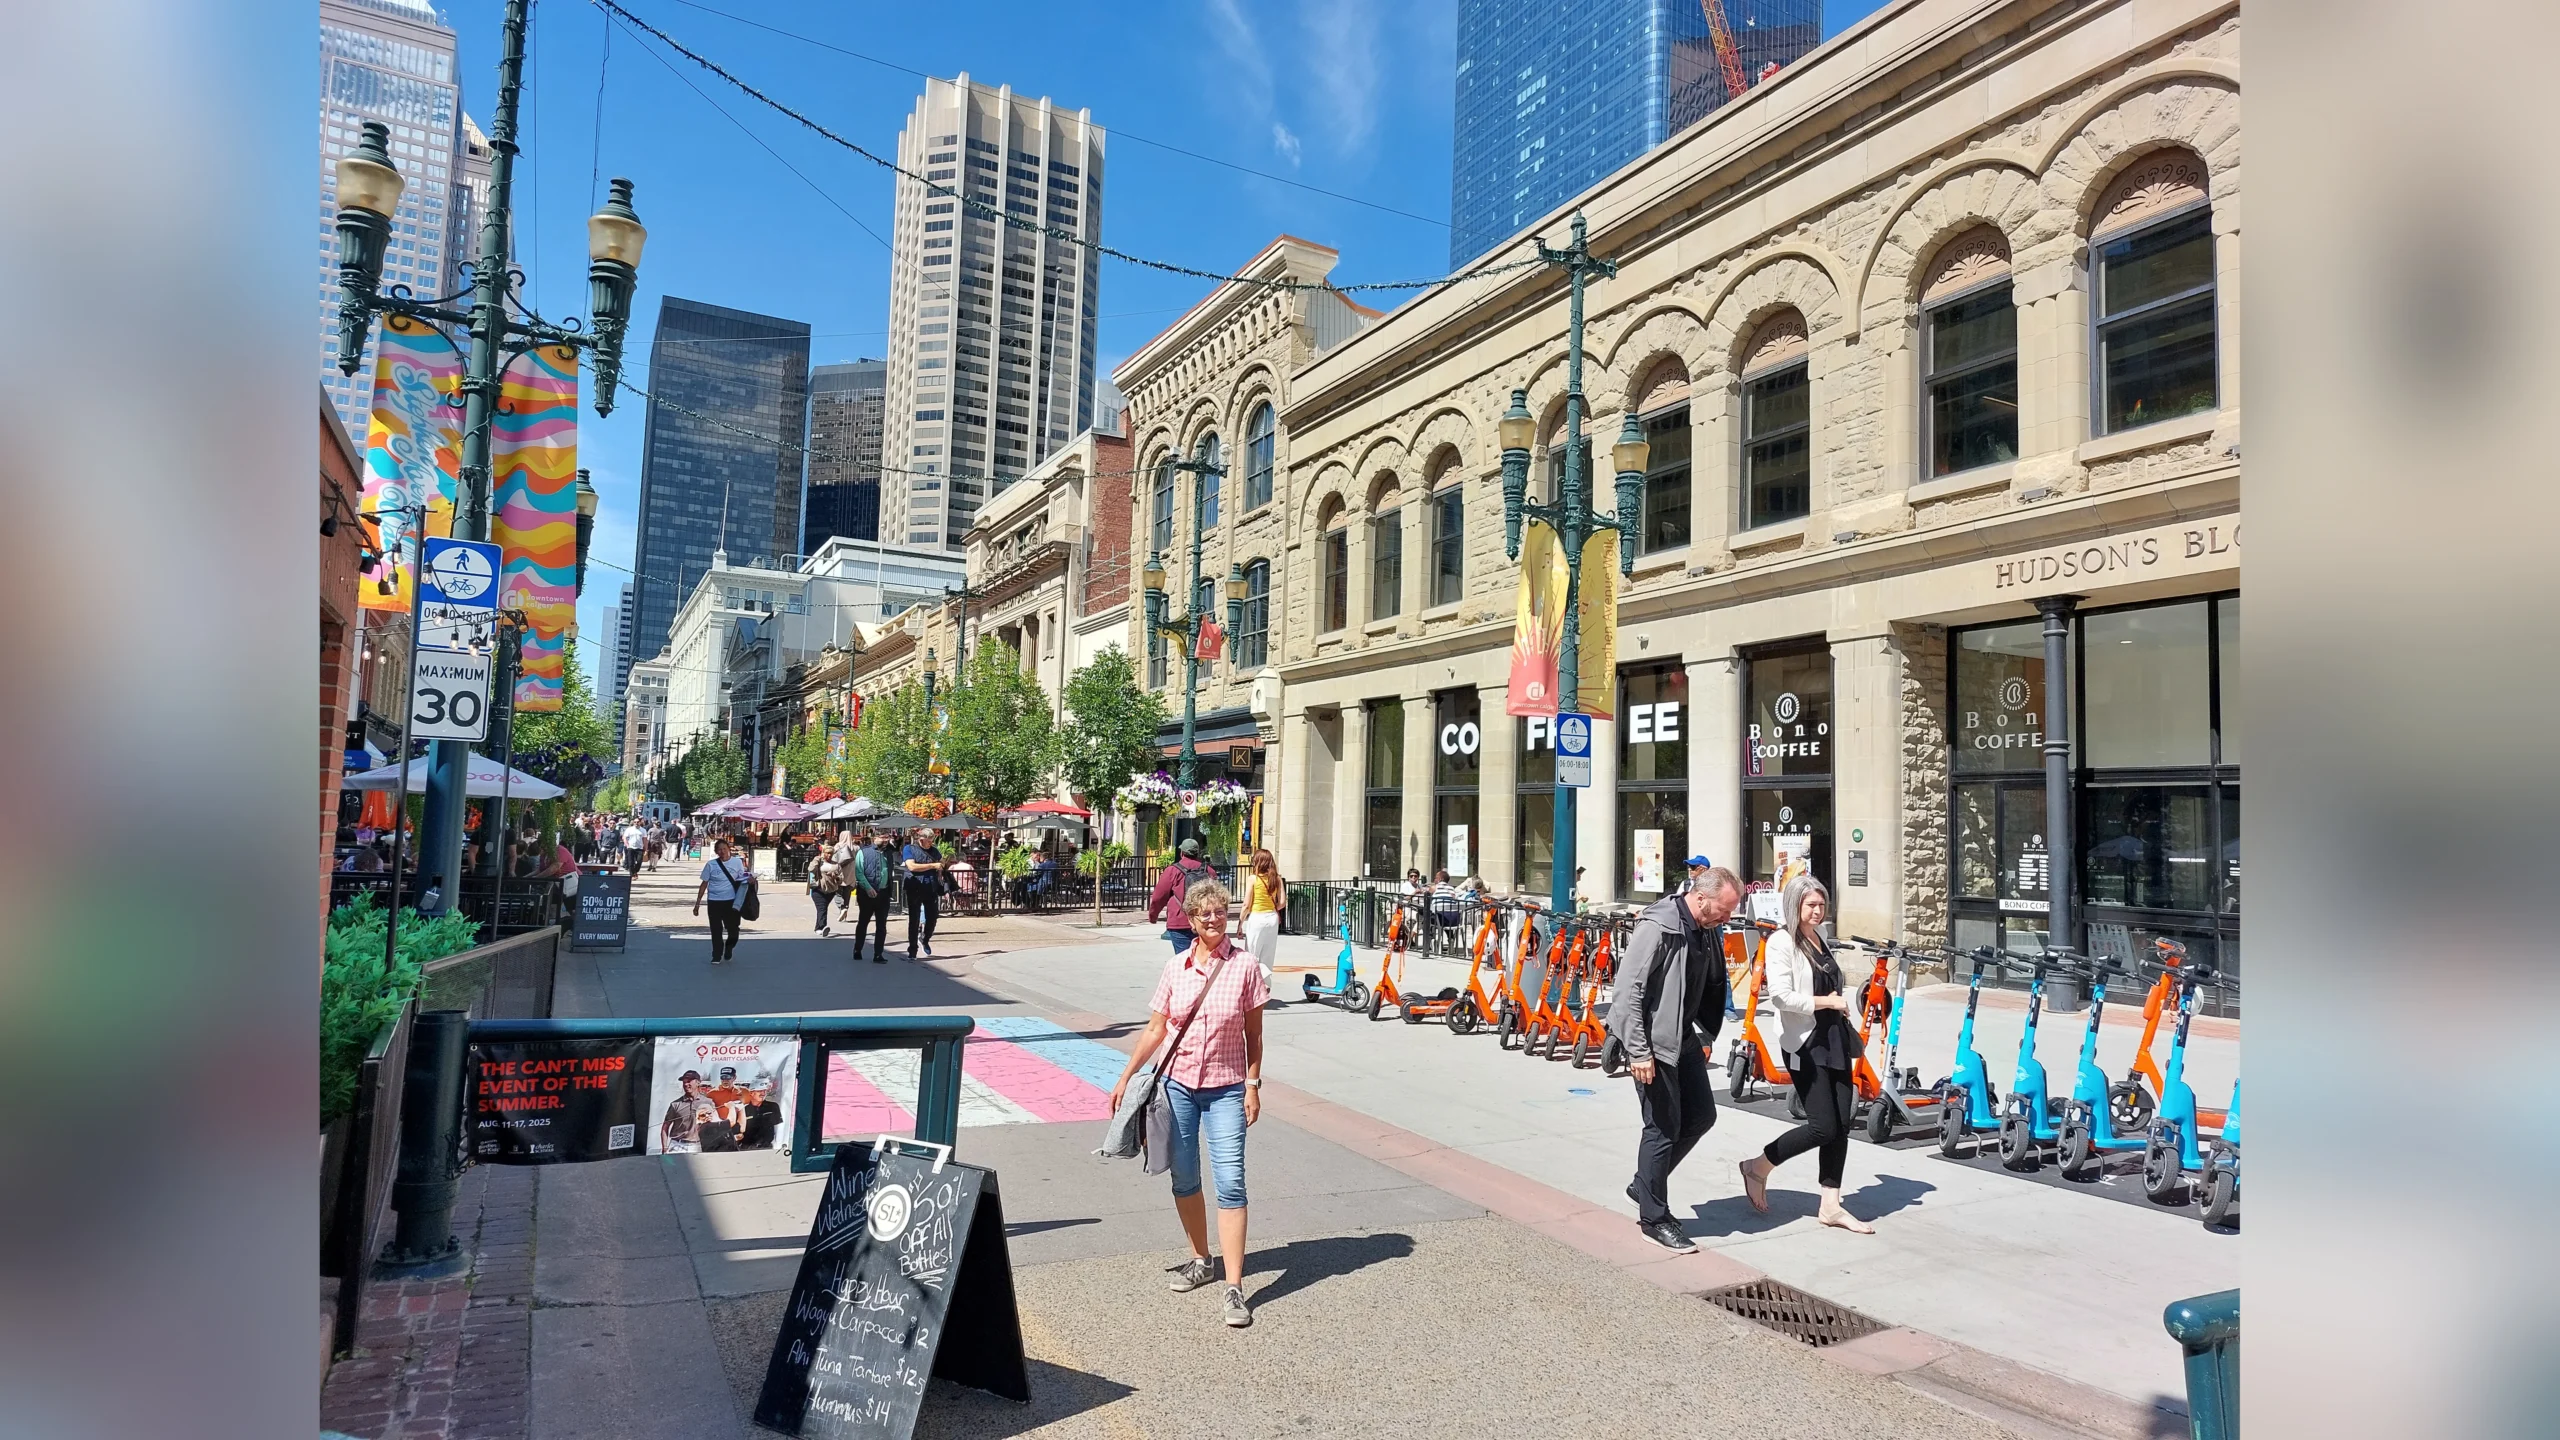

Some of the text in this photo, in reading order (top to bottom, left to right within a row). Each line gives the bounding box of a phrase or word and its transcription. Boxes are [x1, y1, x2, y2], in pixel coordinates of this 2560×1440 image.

[390, 362, 449, 468] Stephen
[1995, 523, 2240, 588] HUDSON'S BL
[526, 594, 564, 602] downtown
[526, 601, 554, 610] calgary
[1602, 536, 1615, 681] Stephen Avenue Walk
[419, 664, 484, 681] MAXIMUM
[413, 688, 481, 728] 30
[1440, 722, 1480, 755] CO
[1629, 701, 1680, 743] EE
[1965, 711, 2038, 729] Bon
[1749, 722, 1828, 740] Bono
[1974, 732, 2042, 750] COFFE
[1751, 739, 1760, 773] OPEN
[1757, 742, 1821, 759] COFFEE
[1559, 760, 1588, 769] 06:00-18:00
[1762, 822, 1811, 832] Bono
[582, 896, 624, 907] 50% OFF
[2004, 901, 2029, 909] BONO
[597, 933, 620, 941] MONDAY
[711, 1044, 760, 1055] ROGERS
[480, 1056, 626, 1077] THE CAN'T MISS
[478, 1074, 608, 1095] EVENT OF THE
[478, 1096, 565, 1113] SUMMER.
[502, 1120, 526, 1129] 11-17,
[528, 1118, 551, 1127] 2025
[831, 1166, 876, 1201] Wine
[913, 1171, 969, 1227] 50%
[831, 1260, 909, 1309] Happy Hour
[796, 1290, 837, 1336] Wagyu
[838, 1303, 906, 1344] Carpaccio
[786, 1338, 810, 1366] Ahi
[815, 1347, 842, 1376] Tuna
[849, 1355, 892, 1388] Tartare
[807, 1377, 863, 1425] Hummus
[865, 1394, 891, 1427] $14
